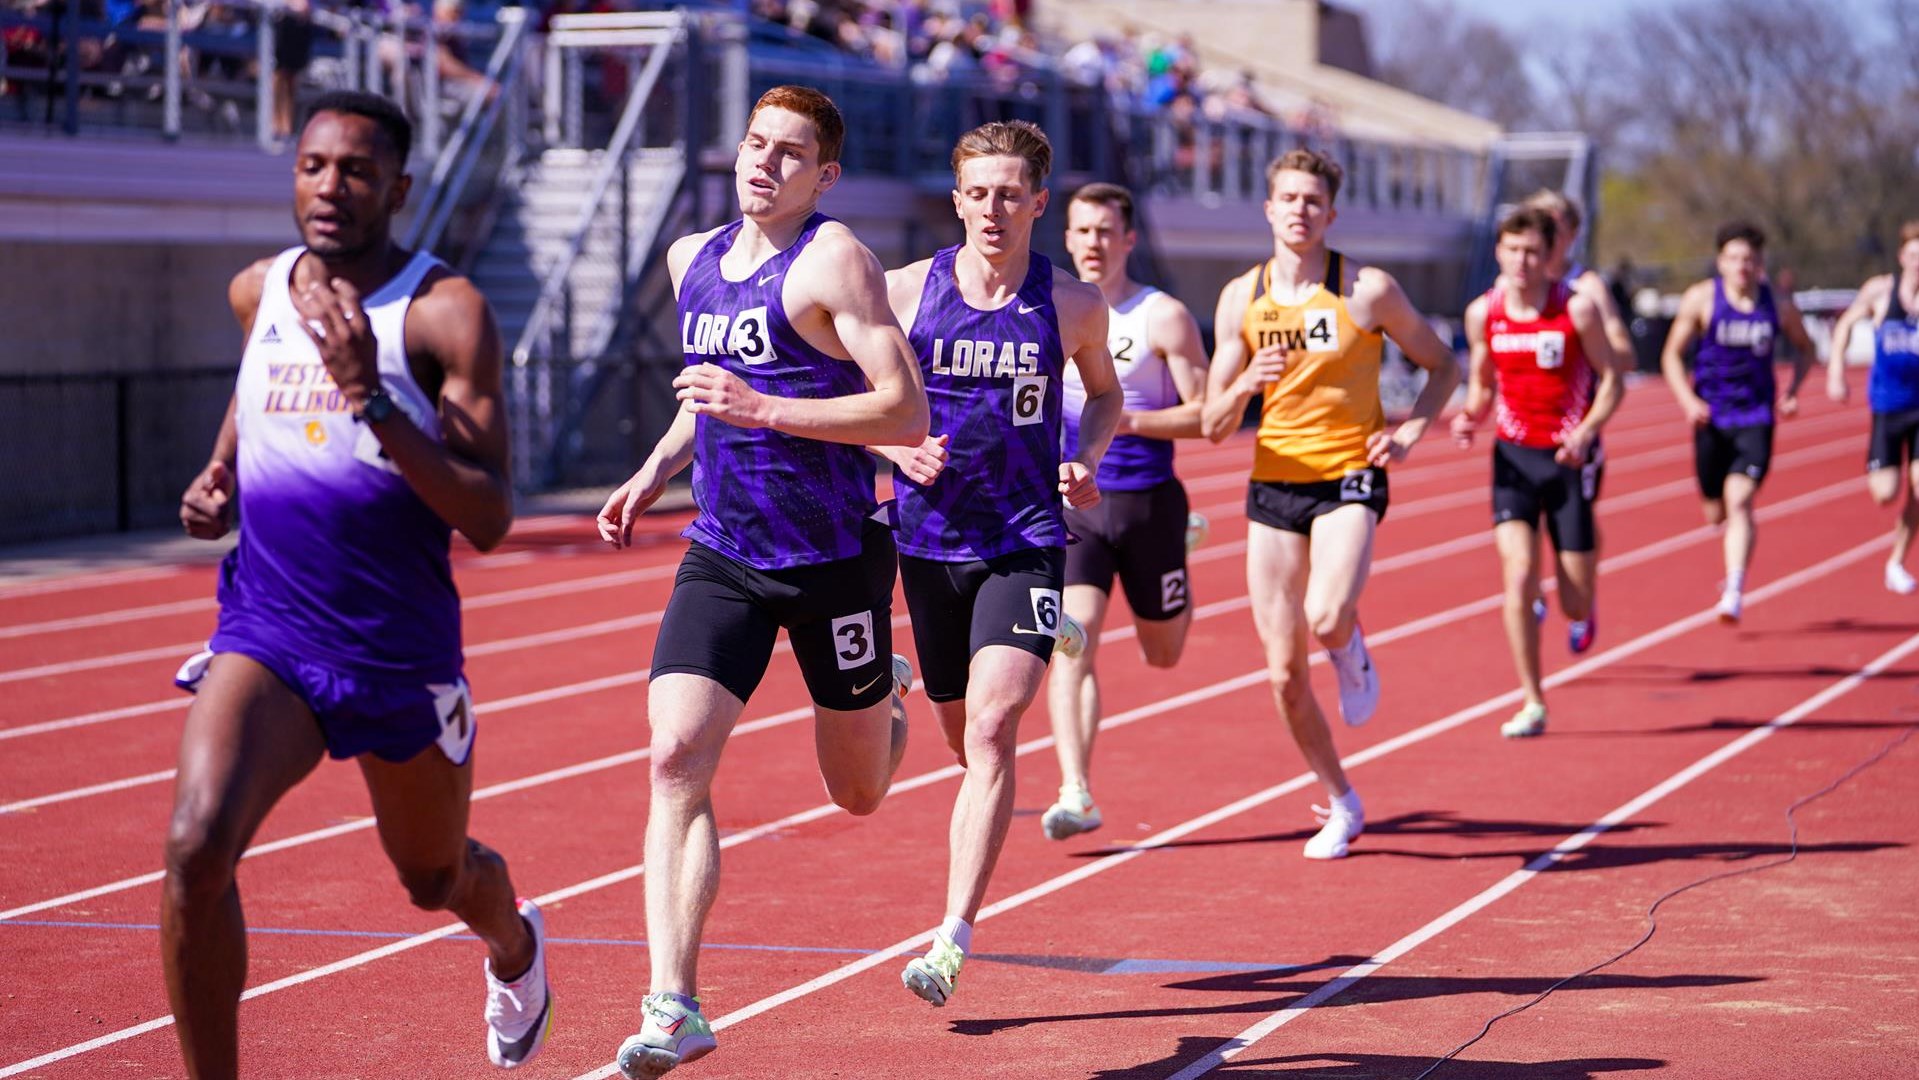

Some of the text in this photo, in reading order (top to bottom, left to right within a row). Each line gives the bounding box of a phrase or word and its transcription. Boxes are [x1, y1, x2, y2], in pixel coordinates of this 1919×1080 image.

[683, 311, 741, 355] LORA
[739, 318, 764, 357] 3
[1258, 329, 1307, 350] IOW
[1310, 317, 1331, 343] 4
[932, 338, 1040, 378] LORAS
[1114, 336, 1134, 362] 2
[267, 362, 336, 385] WEST
[263, 389, 353, 413] ILLINOI
[1016, 384, 1039, 418] 6
[1344, 474, 1366, 494] 4
[1167, 578, 1185, 603] 2
[1037, 596, 1057, 630] 6
[837, 623, 867, 661] 3
[446, 693, 467, 741] 1
